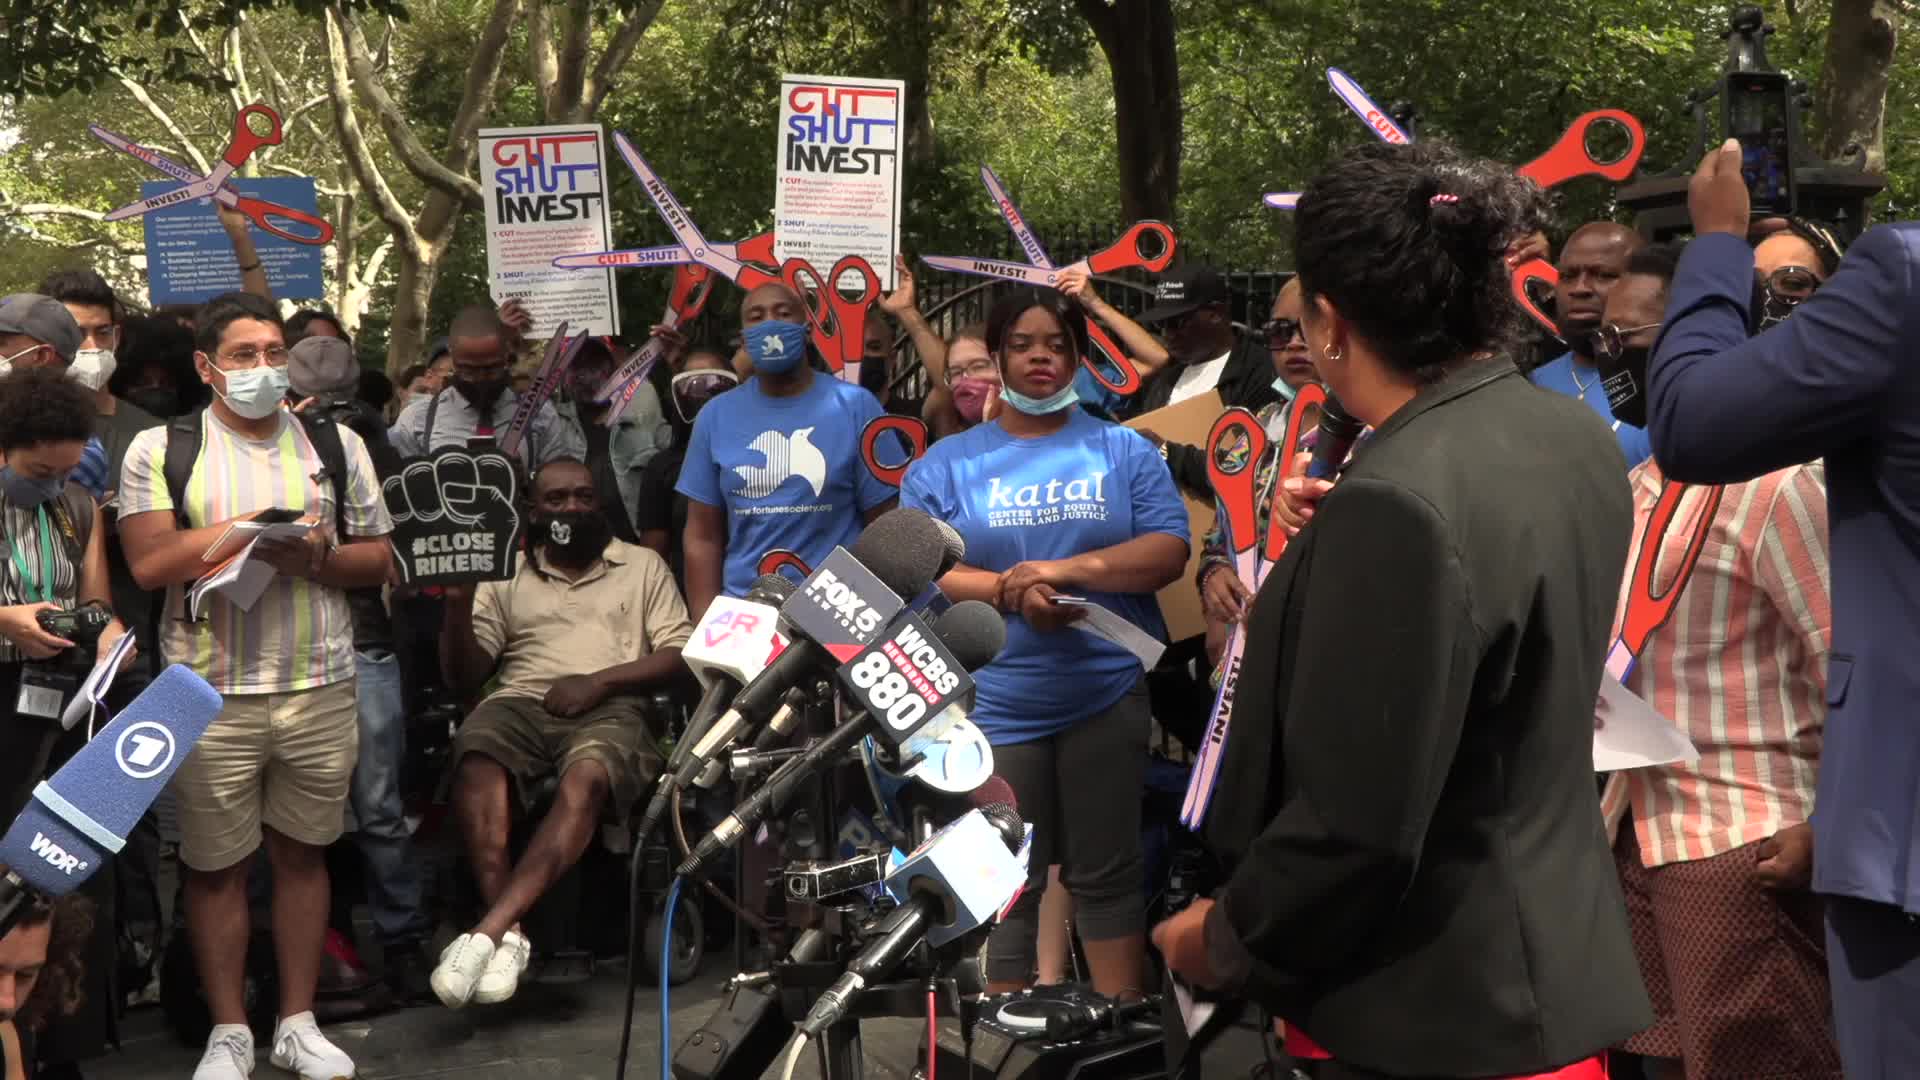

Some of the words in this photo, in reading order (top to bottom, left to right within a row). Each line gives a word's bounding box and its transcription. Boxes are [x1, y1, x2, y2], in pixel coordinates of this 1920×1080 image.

[788, 86, 896, 116] CUT
[788, 104, 896, 145] SHUT
[126, 143, 153, 162] CUT!
[158, 160, 192, 181] SHUT!
[492, 135, 597, 167] CUT
[786, 133, 896, 176] INVEST
[495, 153, 599, 195] SHUT
[144, 189, 191, 209] INVEST!
[495, 186, 602, 225] INVEST
[646, 179, 687, 231] INVEST!
[1001, 199, 1020, 226] CUT!
[1018, 229, 1044, 264] SHUT!
[597, 253, 630, 265] CUT!
[637, 250, 679, 261] SHUT!
[973, 261, 1028, 279] INVEST!
[622, 349, 652, 378] INVEST!
[987, 471, 1107, 508] katal
[988, 509, 1033, 521] CENTER
[1036, 506, 1059, 517] FOR
[989, 518, 1036, 529] HEALTH,
[1037, 514, 1061, 525] AND
[1061, 511, 1107, 522] JUSTICE
[412, 532, 496, 556] #CLOSE
[414, 552, 495, 577] RIKERS
[804, 586, 832, 611] NEW
[833, 611, 867, 642] YORK
[810, 568, 867, 621] FOX
[855, 607, 883, 633] 5
[881, 640, 940, 705] NEWSRADIO
[895, 623, 960, 696] WCBS
[850, 651, 927, 731] 880
[1211, 655, 1242, 745] INVEST!
[30, 831, 79, 876] WDR
